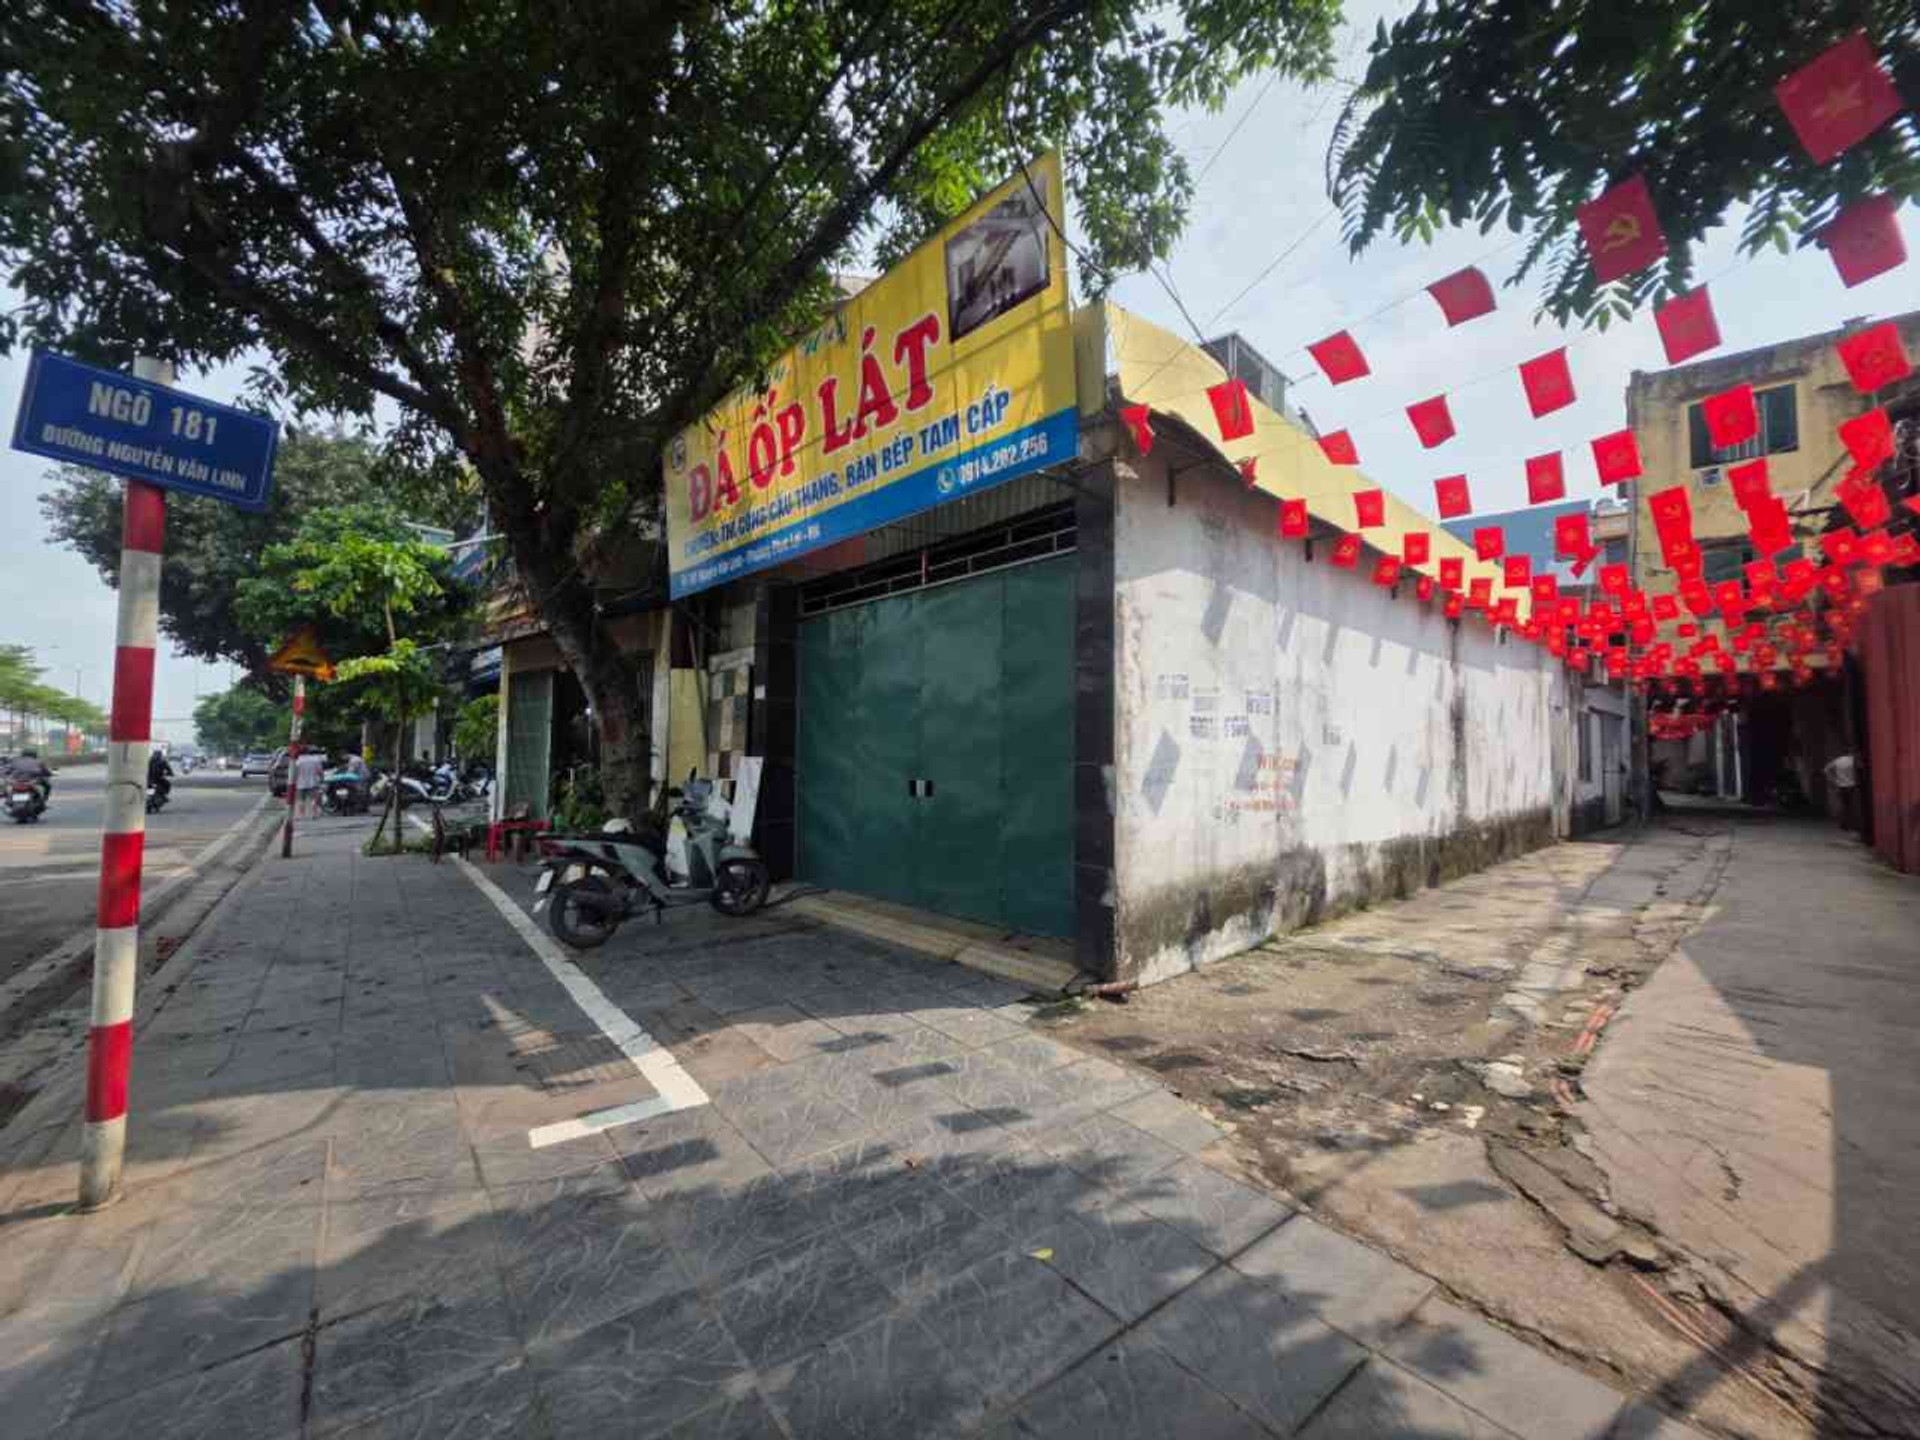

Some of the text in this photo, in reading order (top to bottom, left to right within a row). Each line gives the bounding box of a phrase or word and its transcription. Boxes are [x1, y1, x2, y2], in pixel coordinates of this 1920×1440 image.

[88, 381, 218, 446] NGÕ 181
[689, 312, 940, 524] ĐÁ ỐP LÁT
[846, 452, 877, 488] BÀN
[881, 432, 914, 473] BẾP
[918, 413, 961, 455] TAM
[966, 384, 1009, 434] CẤP
